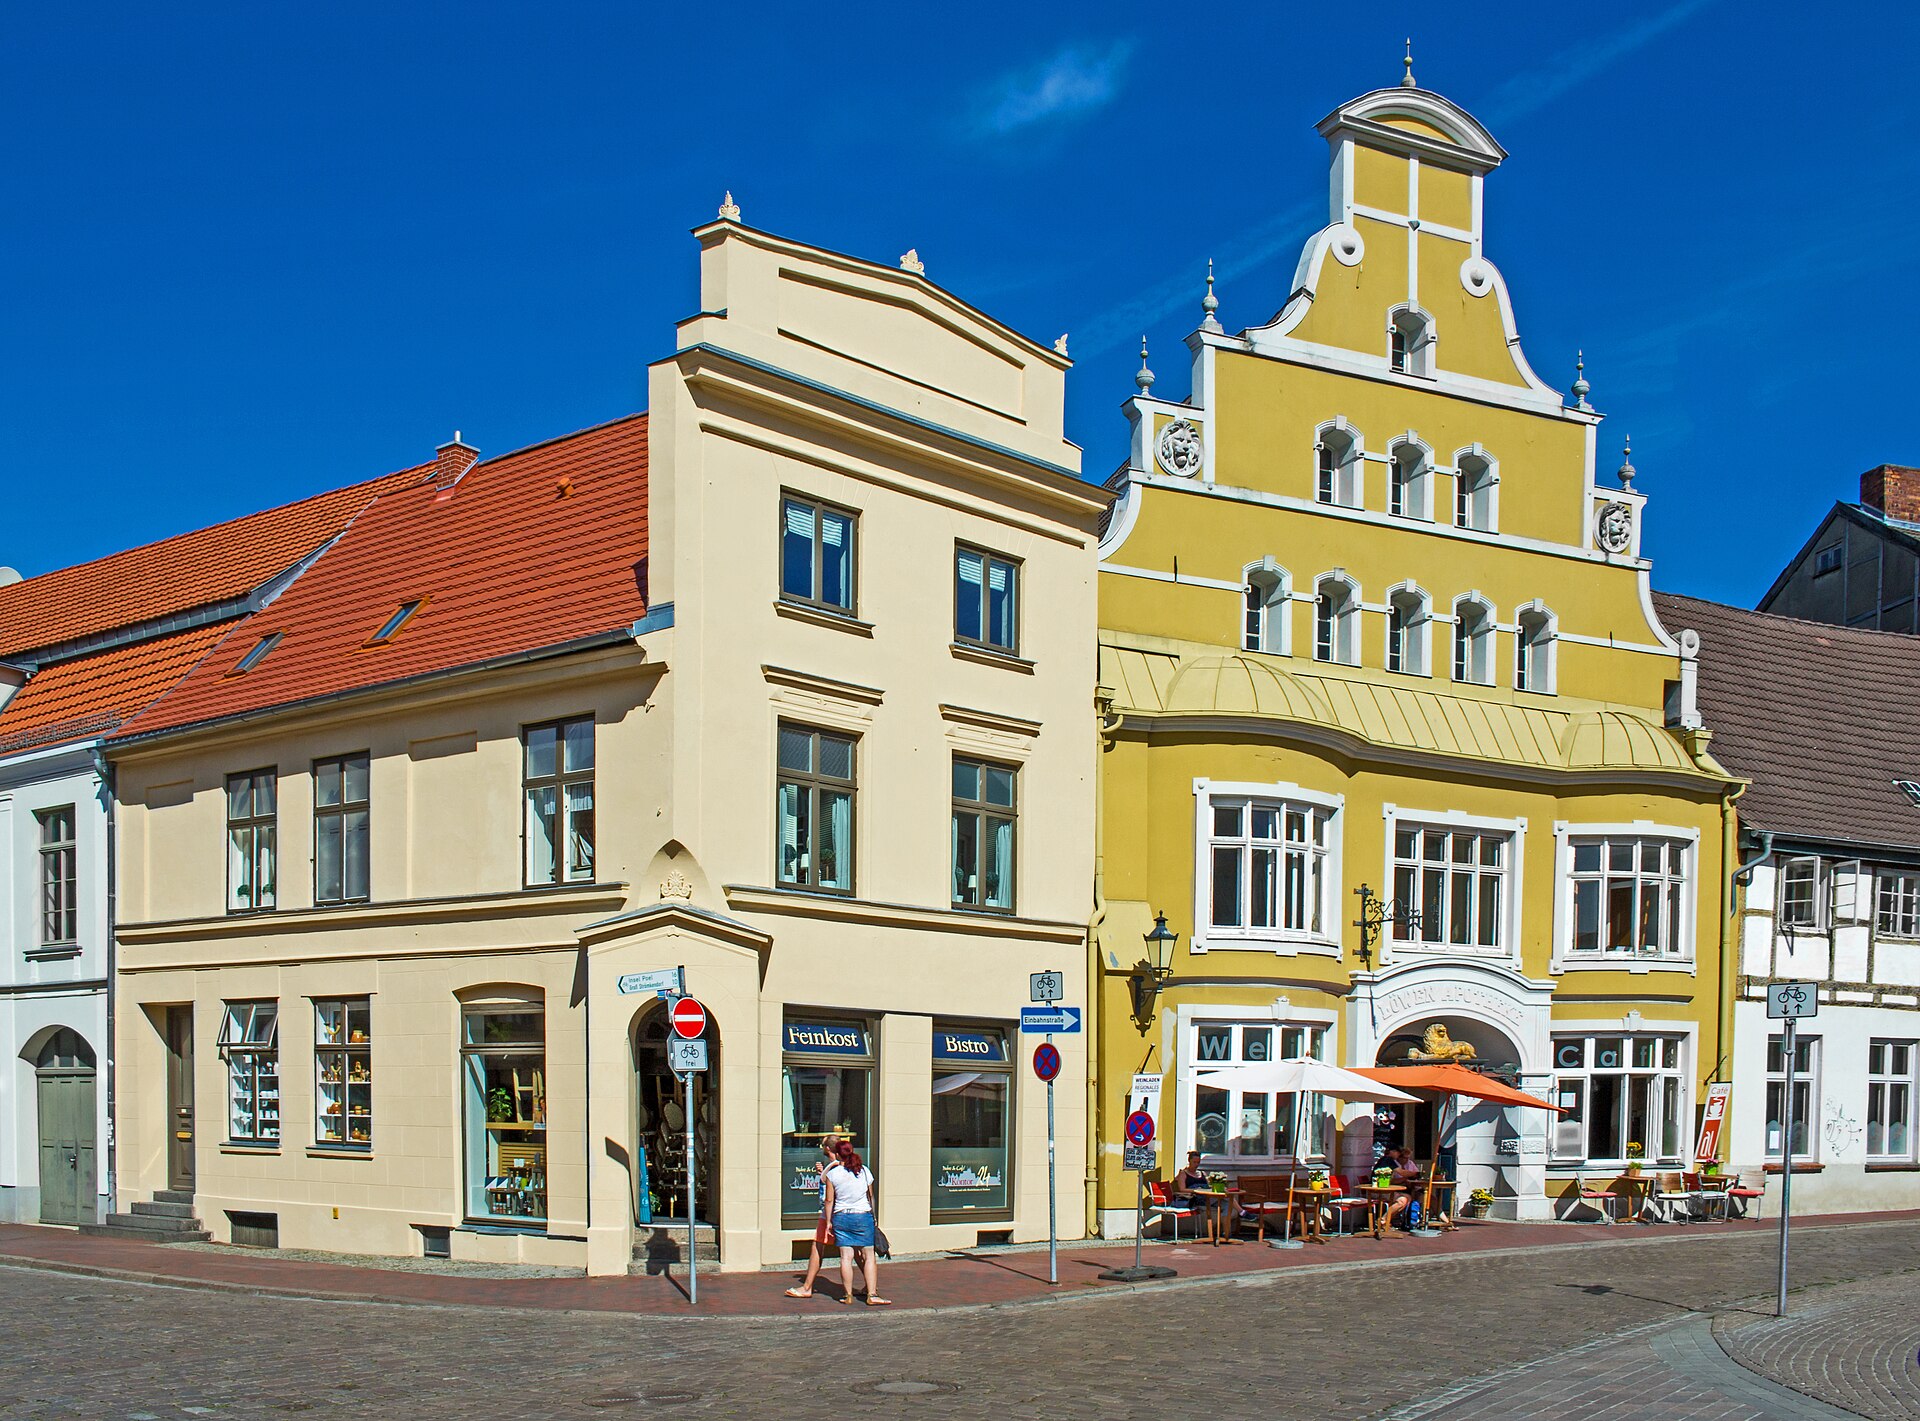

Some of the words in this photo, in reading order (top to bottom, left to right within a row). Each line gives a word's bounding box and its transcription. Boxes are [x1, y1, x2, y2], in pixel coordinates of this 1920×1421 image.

[1024, 1016, 1064, 1024] Einbahnstraße
[788, 1026, 859, 1048] Feinkost
[945, 1035, 990, 1054] Bistro
[1711, 1086, 1729, 1095] Café
[975, 1165, 991, 1187] 24
